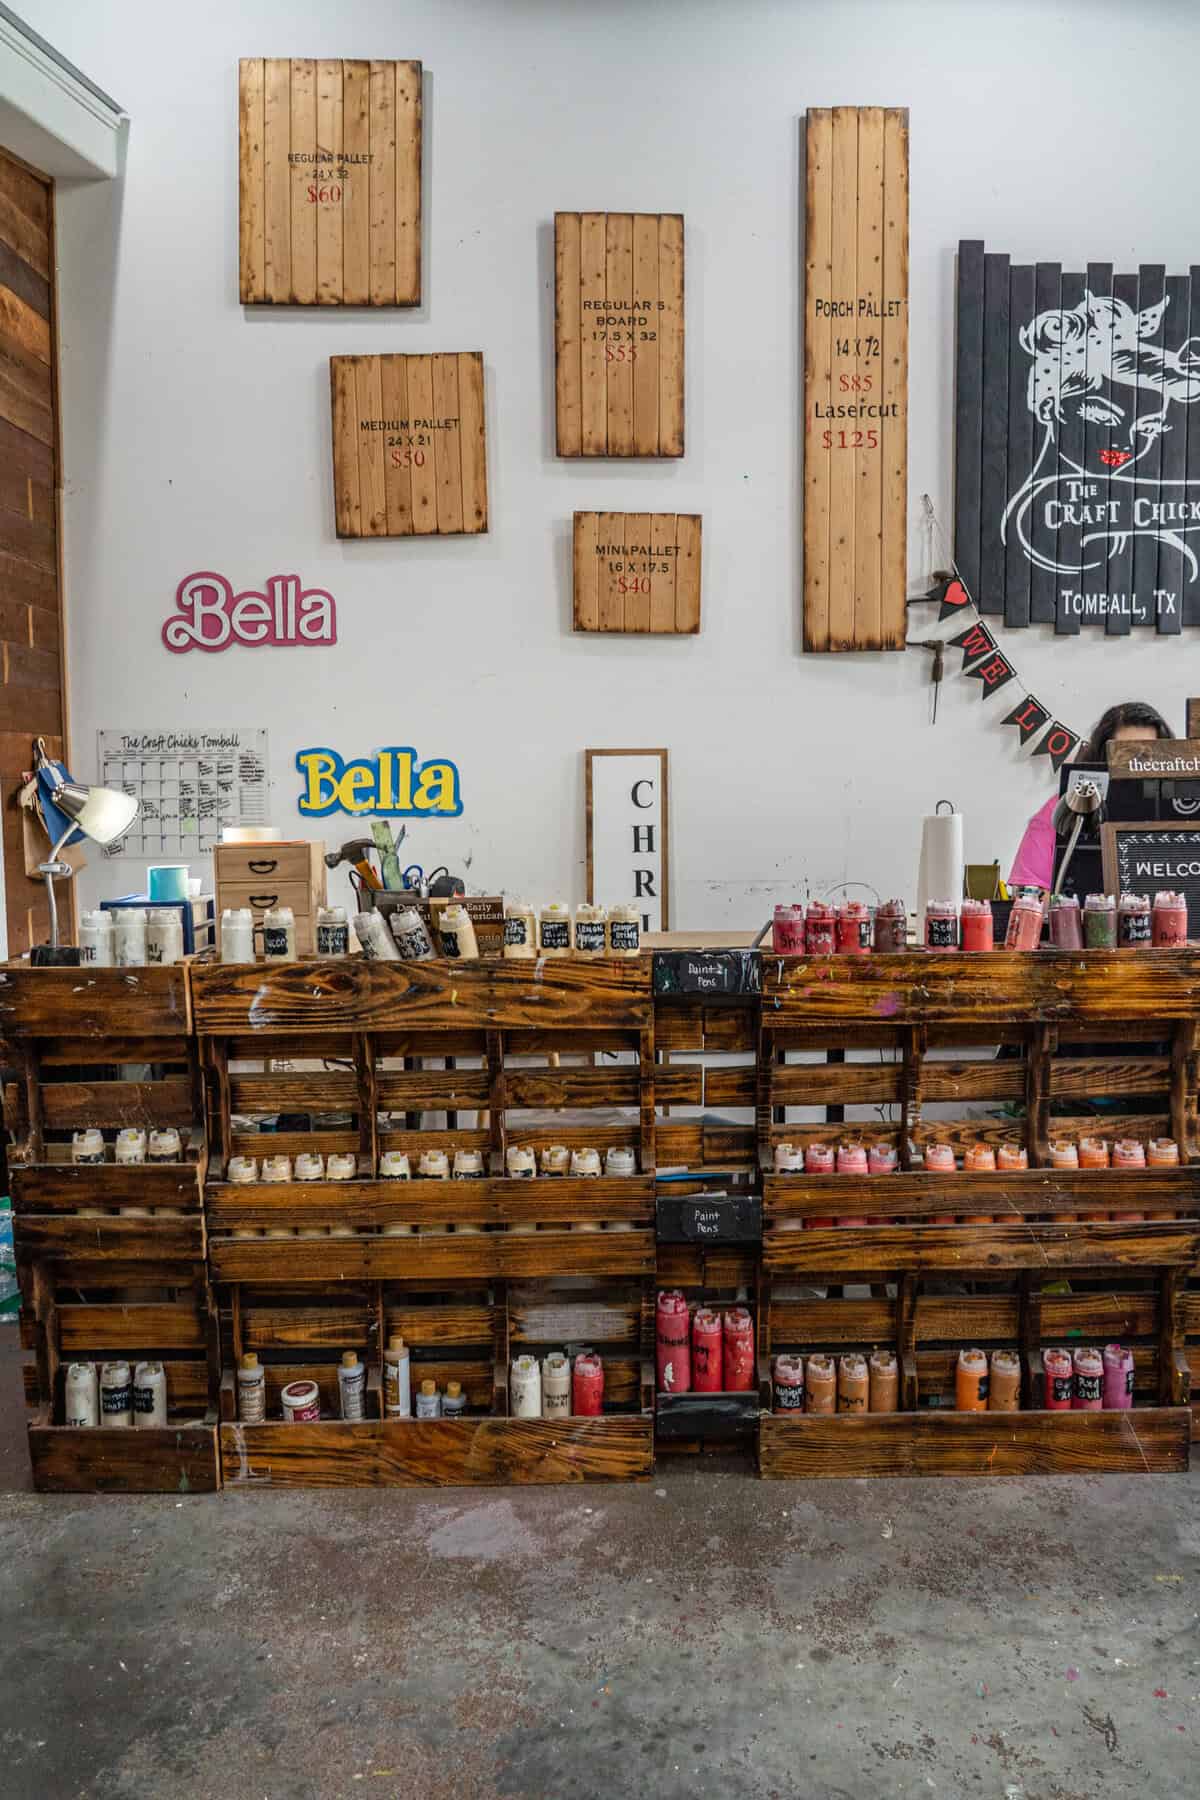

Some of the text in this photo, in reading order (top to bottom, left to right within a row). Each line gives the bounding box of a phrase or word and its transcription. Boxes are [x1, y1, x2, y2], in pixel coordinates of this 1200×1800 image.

[288, 153, 374, 164] REGULAR PALLET
[306, 184, 341, 203] $60
[583, 300, 665, 310] REGULAR 5
[596, 316, 648, 326] BOARD
[592, 332, 622, 340] 17.5
[640, 332, 656, 340] 32
[836, 338, 849, 357] 14
[865, 336, 880, 357] 72
[840, 374, 872, 392] $85
[816, 402, 898, 418] Lasercut
[360, 418, 460, 431] MEDIUM PALLET
[388, 436, 402, 446] 24
[418, 434, 430, 446] 21
[822, 430, 878, 449] $125
[630, 546, 680, 556] PALLET
[609, 562, 623, 572] 16
[642, 562, 669, 573] 17.5
[618, 576, 651, 594] $40
[166, 576, 333, 648] Bella
[120, 734, 240, 750] The Craft Chicks Tomball
[300, 752, 457, 811] Bella
[466, 903, 492, 912] Early
[688, 963, 715, 975] Paint
[698, 976, 716, 987] Pens
[695, 1210, 720, 1221] Paint
[697, 1222, 718, 1232] Pens
